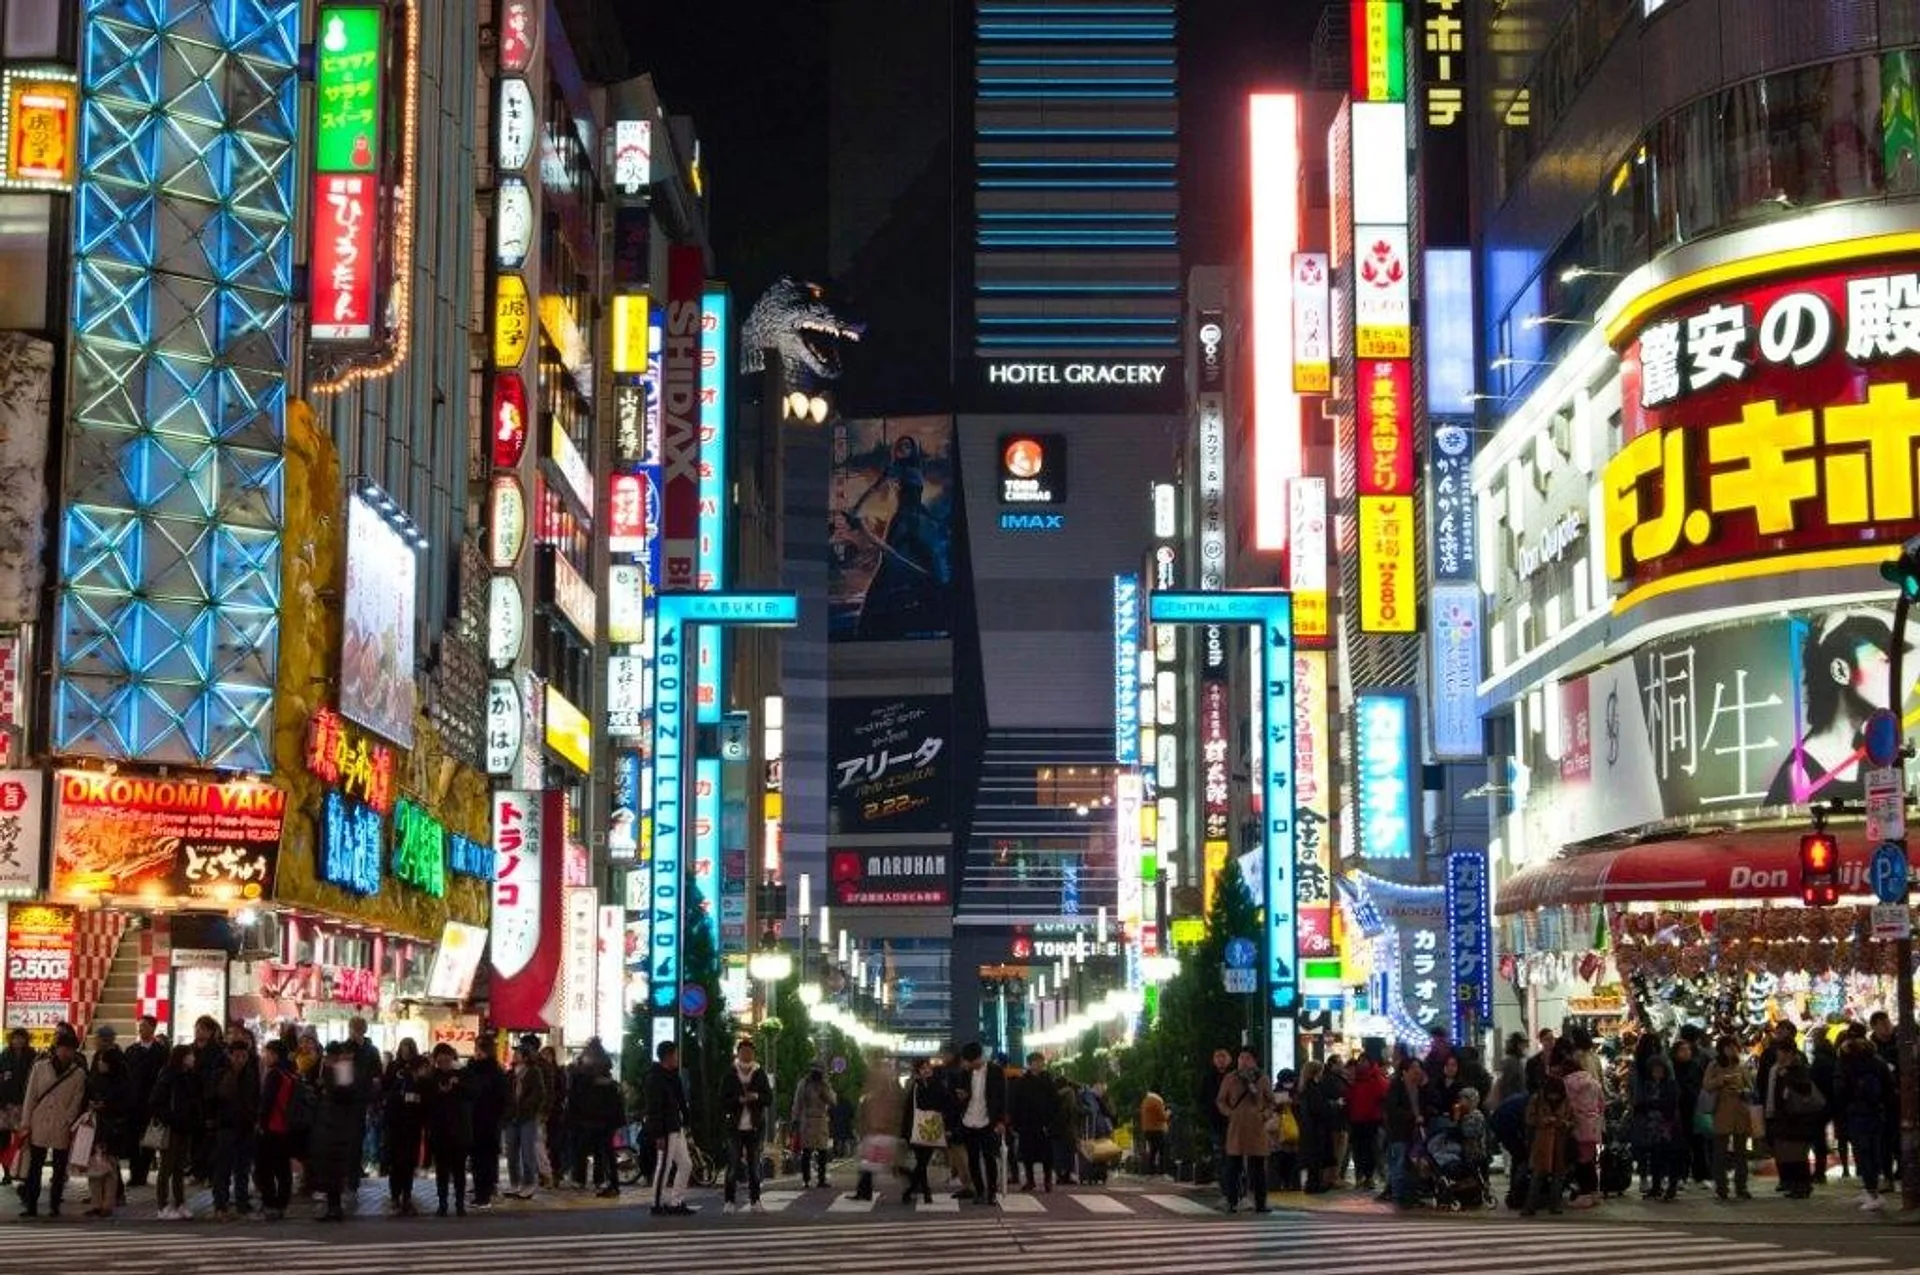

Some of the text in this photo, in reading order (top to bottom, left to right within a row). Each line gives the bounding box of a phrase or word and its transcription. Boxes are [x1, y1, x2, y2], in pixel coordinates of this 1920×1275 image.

[327, 194, 363, 322] ひょうたん
[989, 364, 1166, 383] HOTEL GRACERY
[667, 301, 697, 484] SHIDAX
[1005, 491, 1052, 501] CINEMAS
[1001, 515, 1064, 529] IMAX
[1158, 602, 1226, 613] CENTRAL
[1643, 645, 1784, 804] 桐生
[836, 737, 943, 790] アリータ
[66, 778, 284, 812] OKONOMI YAKI
[656, 654, 678, 946] GODZILLA ROAD
[1270, 680, 1289, 927] ゴジラロード
[151, 825, 186, 837] Drinks
[187, 826, 203, 838] for
[204, 827, 213, 838] 2
[190, 814, 212, 826] with
[497, 802, 523, 906] トラノコ
[867, 855, 946, 876] MARUHAN
[1730, 865, 1789, 889] Don
[1456, 862, 1480, 977] カラオケ
[1413, 930, 1440, 1025] カラオケ
[1458, 984, 1480, 1001] B1
